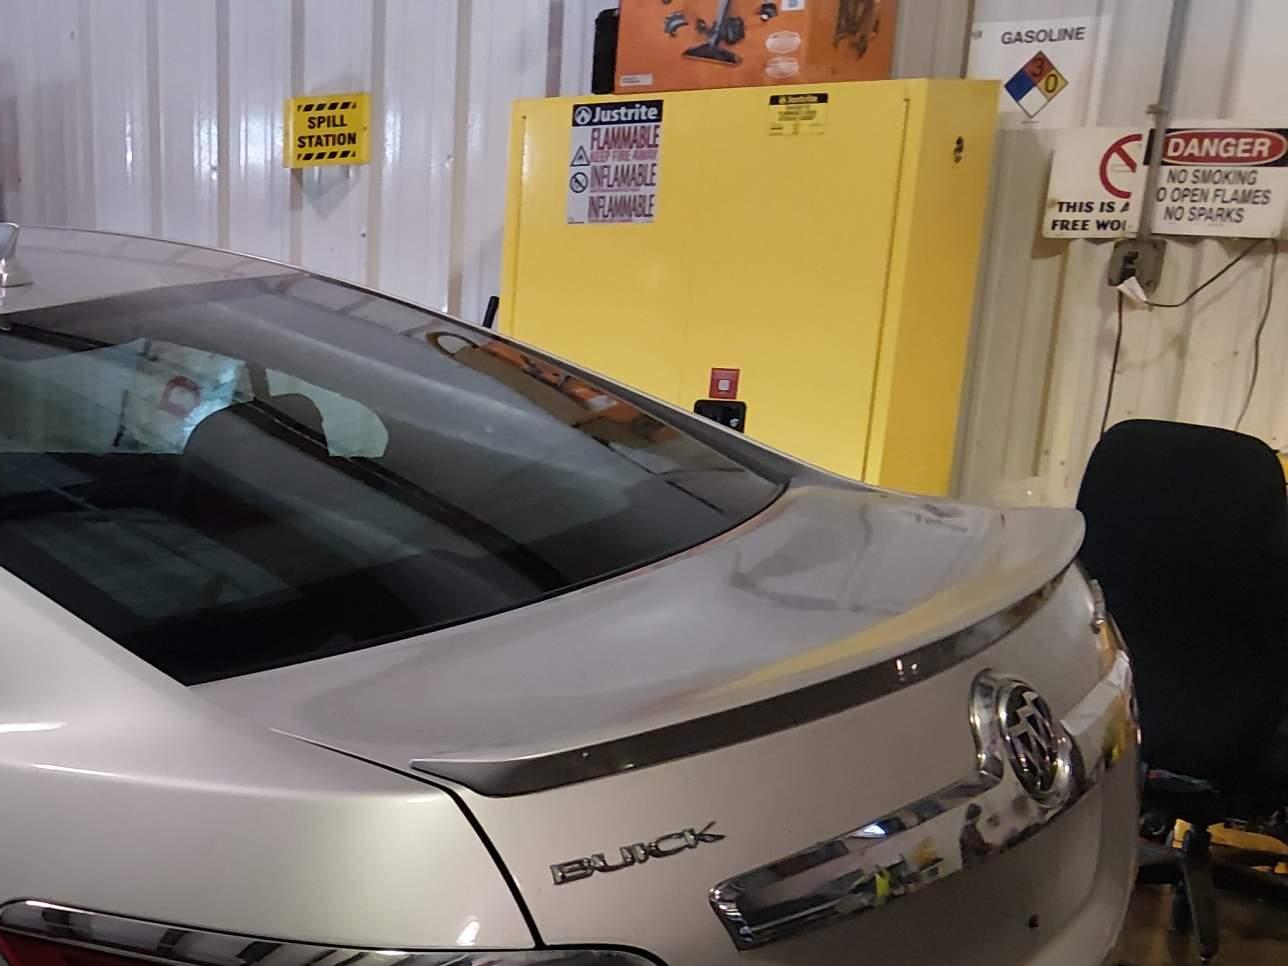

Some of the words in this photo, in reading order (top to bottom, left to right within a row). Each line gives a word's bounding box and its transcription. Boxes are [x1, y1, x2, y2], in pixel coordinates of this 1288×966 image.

[1001, 26, 1087, 45] GASOLINE
[1031, 57, 1044, 78] 3
[1044, 74, 1059, 93] 0
[307, 114, 348, 129] SPILL
[592, 103, 658, 123] Justrite
[297, 132, 357, 149] STATION
[591, 125, 661, 150] FLAMMABLE
[1167, 137, 1271, 158] DANGER
[590, 163, 657, 188] INFLAMABLE
[1166, 169, 1188, 184] NO
[1191, 169, 1258, 186] SMOKING
[1156, 187, 1167, 202] O
[1171, 187, 1210, 203] OPEN
[1212, 188, 1272, 205] FLAMES
[588, 194, 656, 218] INFLAMMABLE
[1056, 201, 1094, 213] THIS
[1099, 201, 1116, 213] IS
[1120, 201, 1130, 213] A
[1164, 206, 1185, 221] NO
[1187, 206, 1245, 223] SPARKS
[1051, 219, 1090, 231] FREE
[550, 820, 726, 885] BUICK
